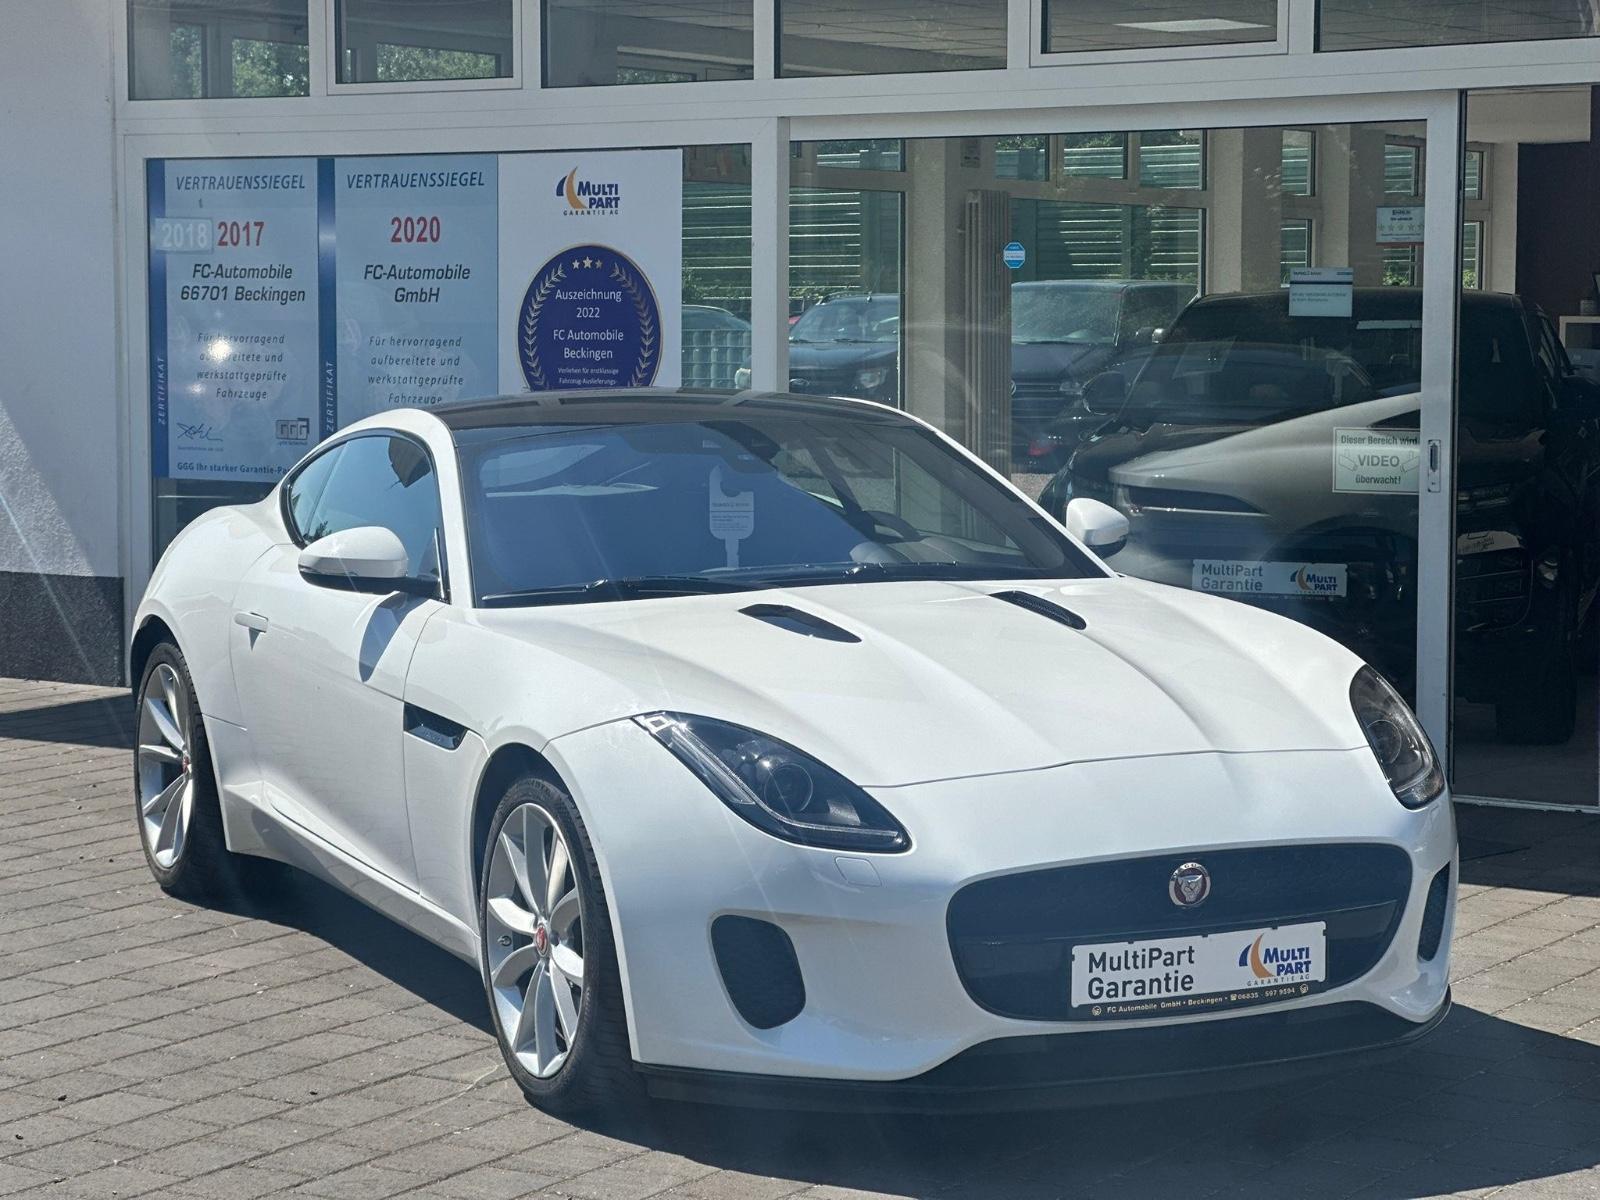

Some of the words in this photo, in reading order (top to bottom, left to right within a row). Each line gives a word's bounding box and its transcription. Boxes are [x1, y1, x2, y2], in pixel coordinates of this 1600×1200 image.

[176, 174, 305, 190] VERTRAUENSSIEGEL
[347, 171, 485, 189] VERTRAUENSSIEGEL
[588, 197, 620, 209] PART
[162, 222, 208, 248] 2018
[217, 221, 265, 247] 2017
[391, 216, 441, 243] 2020
[192, 263, 293, 279] FC-Automobile
[364, 264, 471, 280] FC-Automobile
[180, 285, 229, 301] 66701
[234, 285, 306, 306] Beckingen
[394, 287, 440, 303] GmbH
[555, 289, 622, 302] Auszeichnung
[576, 307, 600, 318] 2022
[369, 335, 386, 346] Für
[389, 336, 463, 349] hervorragend
[553, 330, 565, 340] FC
[567, 330, 624, 341] Automobile
[265, 352, 284, 363] und
[564, 347, 613, 360] Beckingen
[371, 355, 436, 366] aufbereitete
[440, 356, 460, 367] und
[197, 370, 287, 382] werkstattgeprüfte
[368, 375, 464, 387] werkstattgeprüfte
[157, 357, 166, 425] ZERTIFIKAT
[216, 387, 268, 400] Fahrzeuge
[325, 361, 335, 431] ZERTIFIKAT
[1341, 435, 1365, 444] Dieser
[1367, 436, 1398, 445] Bereich
[1400, 436, 1418, 446] wird
[177, 462, 195, 471] GGG
[196, 463, 208, 471] Ihr
[209, 464, 238, 473] starker
[1358, 455, 1400, 467] VIDEO
[1355, 474, 1401, 485] überwacht!
[1201, 564, 1263, 577] MultiPart
[1201, 577, 1263, 591] Garantie
[1314, 583, 1338, 591] PART
[1088, 945, 1195, 973] MultiPart
[1276, 960, 1312, 977] PART
[1087, 970, 1194, 1000] Garantie
[1246, 976, 1295, 987] GARANTIE
[1118, 1003, 1158, 1012] Automobile
[1160, 1000, 1181, 1009] GmbH
[1187, 996, 1223, 1006] Beckingen
